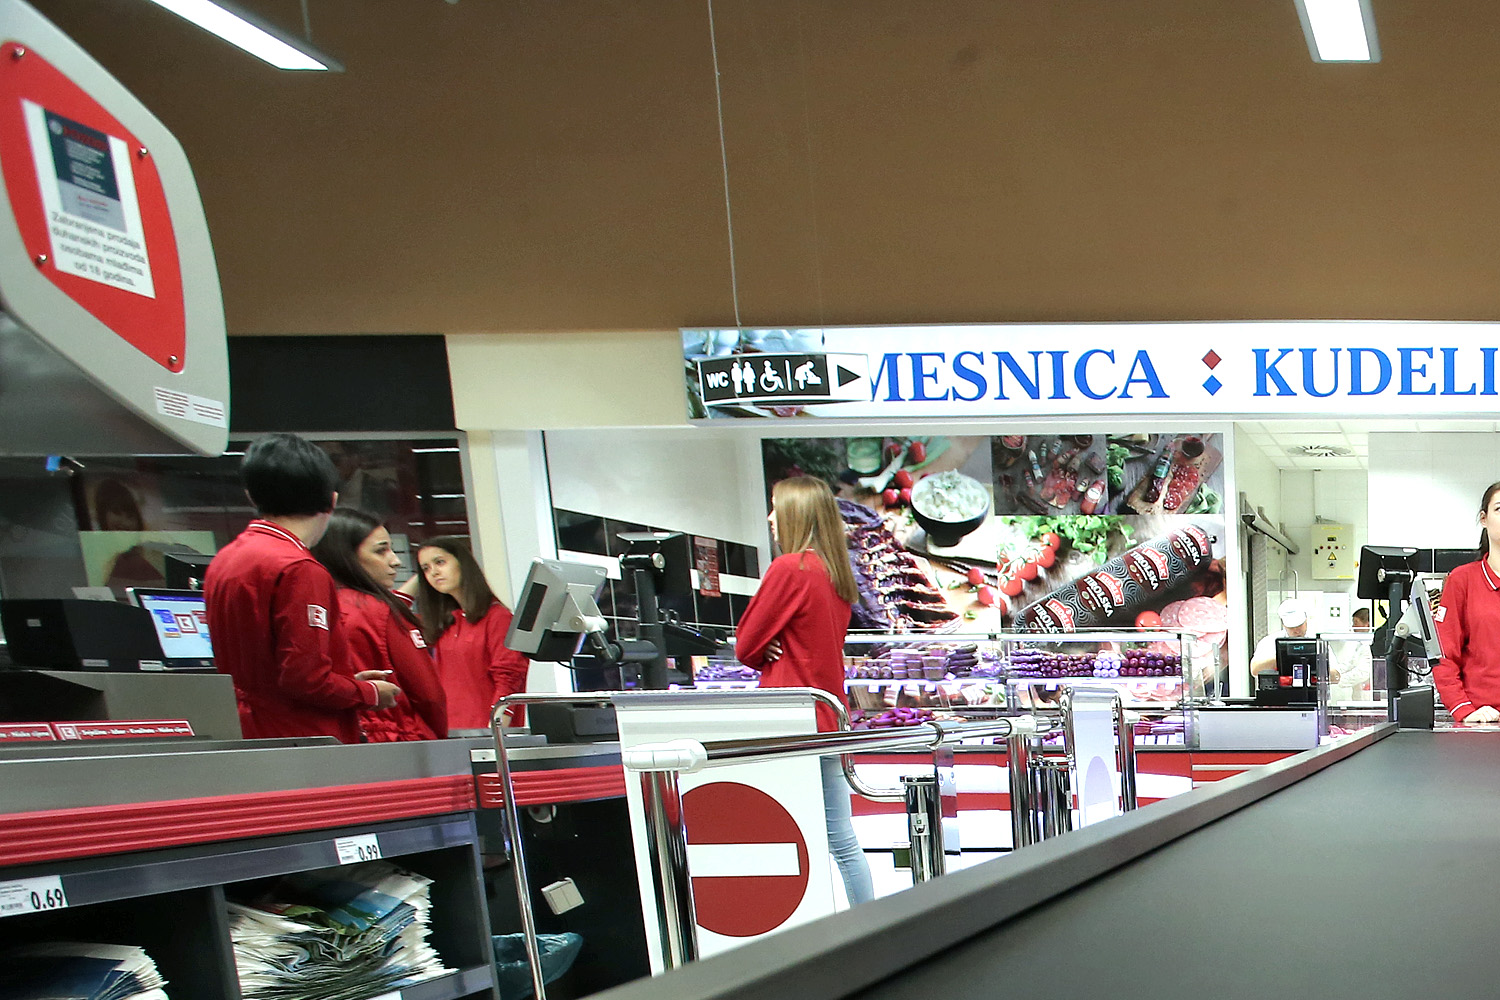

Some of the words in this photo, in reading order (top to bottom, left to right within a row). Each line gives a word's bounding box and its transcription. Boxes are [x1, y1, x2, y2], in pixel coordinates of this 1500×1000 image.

[705, 371, 729, 389] WC
[1130, 550, 1159, 590] TIROLSKA
[1083, 575, 1114, 618] TIROLSKA
[358, 844, 378, 861] 0.99
[31, 888, 63, 910] 0.69
